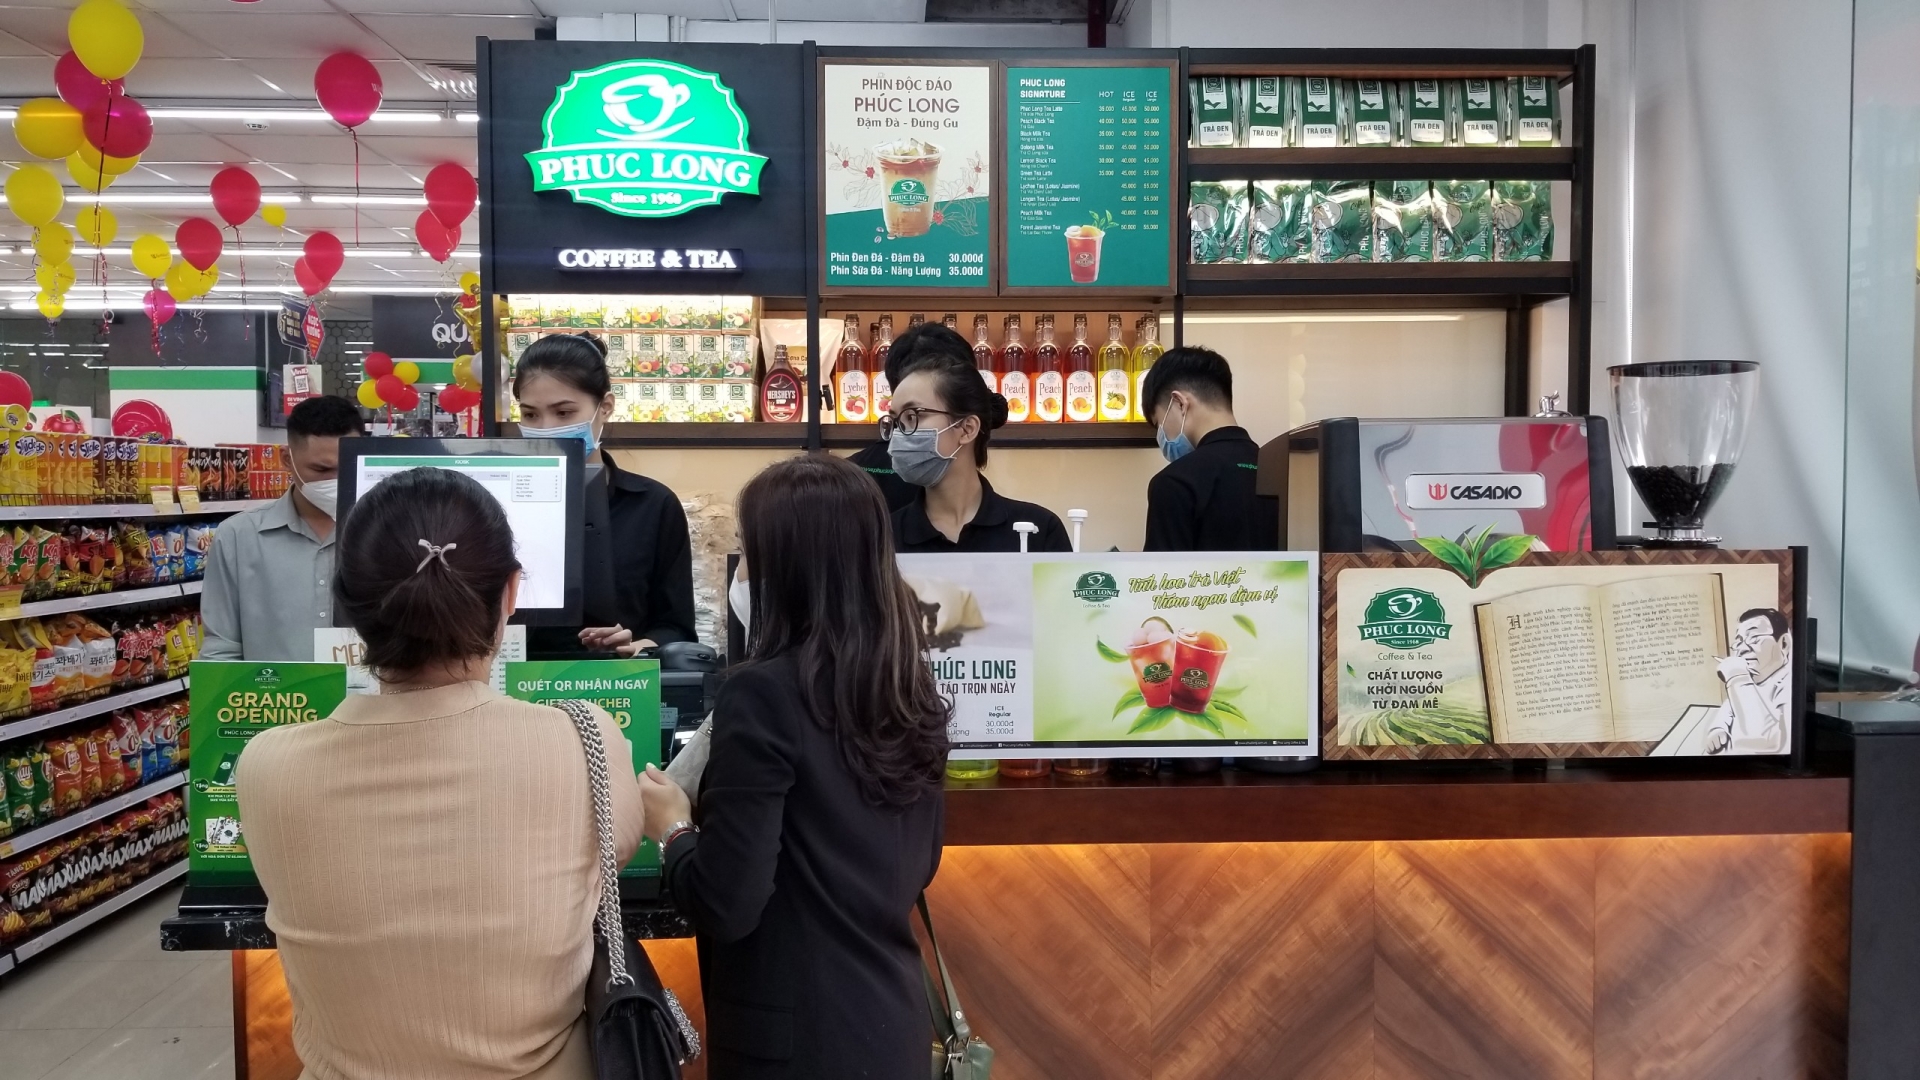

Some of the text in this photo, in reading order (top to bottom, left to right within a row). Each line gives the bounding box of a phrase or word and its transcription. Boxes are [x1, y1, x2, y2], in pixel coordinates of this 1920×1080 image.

[862, 76, 952, 93] PHIN ĐỘC ĐÁO
[1020, 78, 1066, 87] PHUC LONG
[1020, 90, 1066, 98] SIGNATURE
[854, 93, 960, 113] PHÚC LONG
[857, 117, 958, 130] Đậm Đà Đúng Gu
[538, 152, 752, 187] PHUC LONG
[558, 250, 736, 268] COFFEE & TEA
[830, 251, 984, 264] Phin Đen Đá Đậm Đà 30.000đ
[830, 265, 849, 276] Phin
[852, 265, 869, 276] Sữa
[871, 265, 882, 276] Đá
[915, 266, 941, 278] Lượng
[948, 266, 984, 276] 35.000đ
[767, 390, 795, 399] HERSHEY'S
[843, 383, 867, 394] Lychee
[1004, 383, 1026, 396] Peach
[1039, 382, 1061, 395] Peach
[1069, 382, 1092, 395] Peach
[1450, 486, 1522, 500] CASADIO
[1128, 566, 1246, 593] Tinh hoa trà Việt
[1191, 593, 1227, 610] ngon
[1230, 585, 1262, 606] đậm
[1264, 585, 1279, 603] vị
[1363, 624, 1447, 638] PHUC LONG
[1378, 652, 1405, 661] Coffee
[1417, 652, 1432, 660] Tea
[932, 657, 1016, 680] HÚC LONG
[1367, 667, 1443, 682] CHẤT LƯỢNG
[517, 678, 649, 692] QUÉT QR NHẬN NGAY
[940, 680, 1016, 696] TÁO TRỌN NGÀY
[1367, 681, 1444, 695] KHỞI NGUỒN
[228, 692, 308, 708] GRAND
[1372, 697, 1439, 709] TỪ ĐAM MÊ
[217, 708, 318, 724] OPENING
